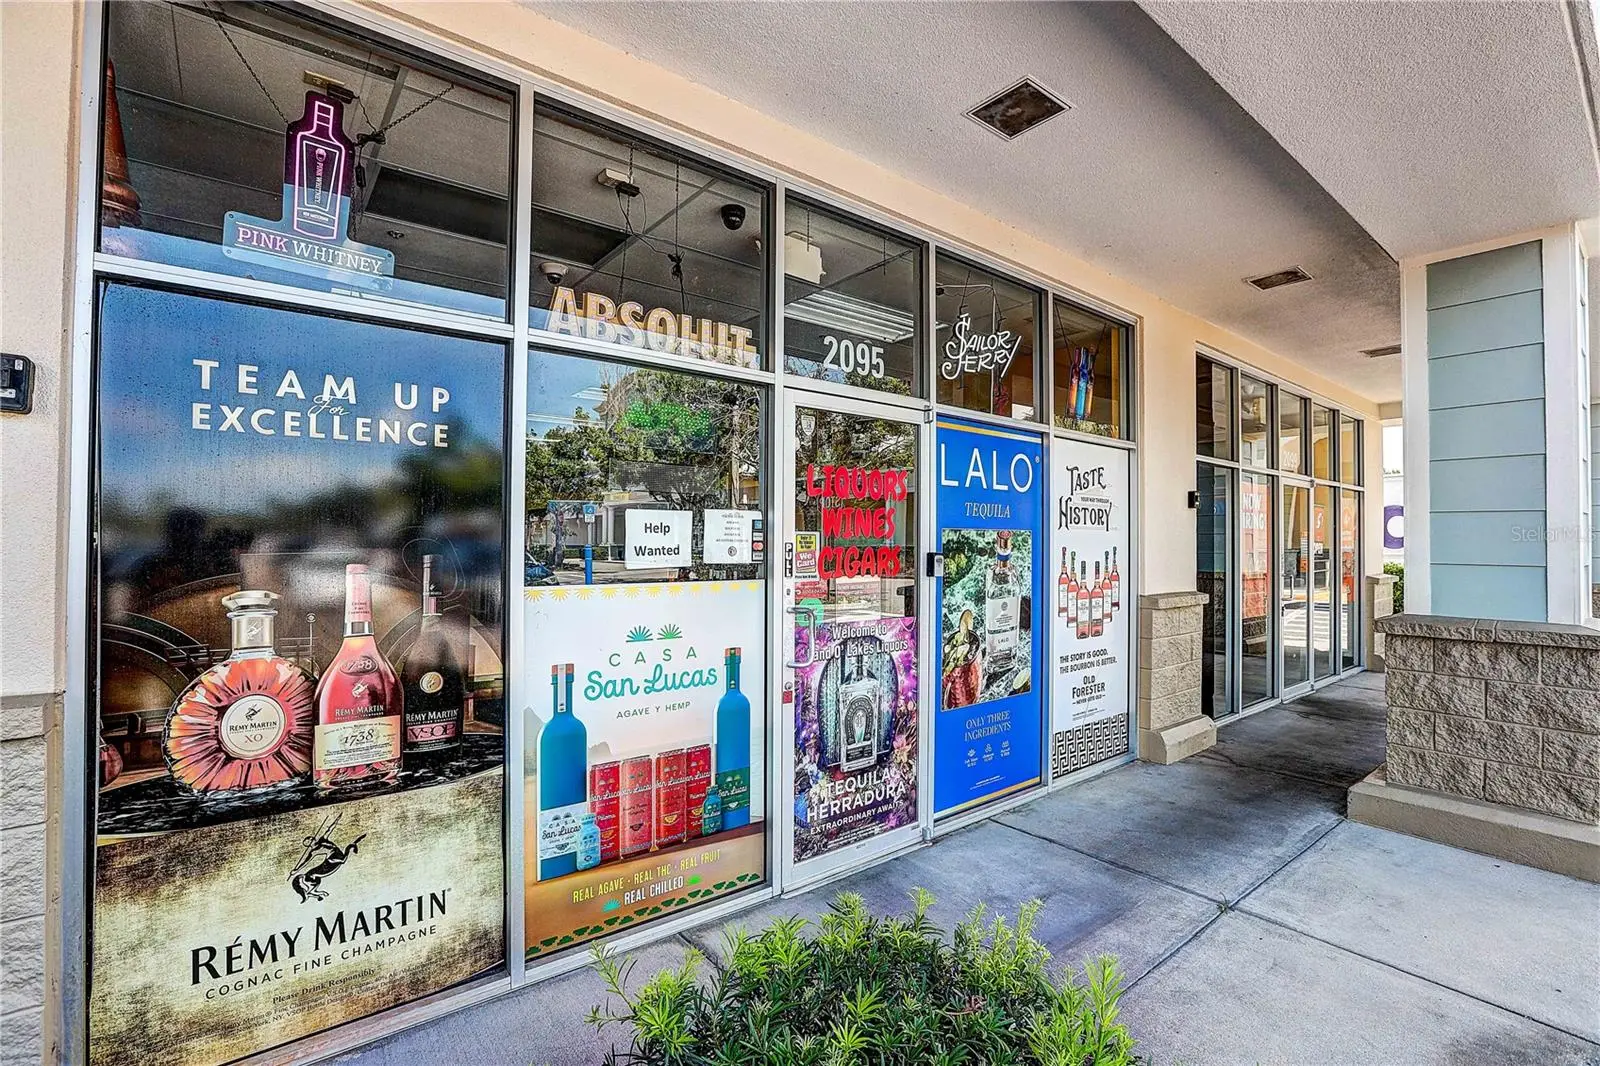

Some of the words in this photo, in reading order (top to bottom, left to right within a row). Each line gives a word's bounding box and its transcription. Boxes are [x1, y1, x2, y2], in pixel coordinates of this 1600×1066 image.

[236, 226, 288, 253] PINK
[292, 241, 383, 274] WHITNEY
[545, 286, 759, 370] ABSOLUT
[945, 314, 1011, 359] SAILOR
[823, 335, 885, 379] 2095
[941, 335, 1022, 380] JERRY
[192, 358, 357, 405] TEAM
[394, 382, 450, 413] UP
[307, 393, 351, 419] For
[192, 402, 449, 448] EXCELLENCE
[941, 443, 1033, 493] LALO
[806, 463, 908, 502] LIQUORS
[1066, 465, 1107, 496] TASTE
[965, 502, 1010, 520] TEQUILA
[1243, 493, 1262, 510] NOW
[822, 506, 897, 539] WINES
[1058, 496, 1112, 532] HISTORY
[643, 522, 671, 536] Help
[634, 544, 680, 557] Wanted
[785, 543, 793, 577] PULL
[799, 552, 812, 560] We
[817, 544, 901, 580] CIGARS
[796, 559, 816, 568] Card
[831, 624, 879, 640] Welcome
[879, 624, 887, 635] to
[608, 646, 698, 667] CASA
[811, 648, 831, 661] and
[834, 645, 844, 659] O'
[847, 642, 875, 657] Lakes
[876, 640, 908, 654] Liquors
[1060, 655, 1069, 664] THE
[1070, 652, 1086, 662] STORY
[1086, 651, 1091, 659] IS
[1060, 666, 1069, 674] THE
[1070, 661, 1095, 672] BOURBON
[1095, 659, 1100, 667] IS
[584, 670, 640, 701] San
[643, 663, 718, 695] Lucas
[1072, 682, 1106, 699] FORESTER
[1083, 675, 1096, 685] OLD
[356, 705, 384, 714] MARTIN
[428, 710, 457, 720] MARTIN
[616, 707, 650, 719] AGAVE
[655, 705, 661, 713] Y
[665, 701, 691, 712] HEMP
[965, 715, 986, 729] ONLY
[987, 710, 1011, 721] THREE
[250, 721, 277, 729] MARTIN
[409, 723, 455, 740] VSOP
[964, 721, 1012, 742] INGREDIENTS
[245, 734, 263, 743] XO
[343, 728, 375, 747] 1738
[826, 767, 892, 798] TEQUILA
[807, 781, 906, 823] HERRADURA
[548, 819, 576, 829] CASA
[810, 808, 877, 834] EXTRAORDINARY
[876, 800, 904, 814] AWAITS
[542, 830, 557, 840] San
[558, 825, 581, 837] Lucas
[572, 888, 593, 904] REAL
[598, 877, 624, 895] AGAVE
[634, 869, 654, 885] REAL
[656, 864, 672, 878] THC
[680, 859, 697, 872] REAL
[700, 849, 721, 864] FRUIT
[624, 889, 646, 905] REAL
[649, 876, 684, 898] CHILLED
[190, 927, 303, 986] RÉMY
[314, 889, 447, 951] MARTIN
[205, 969, 284, 1000] COGNAC
[293, 956, 332, 975] FINE
[341, 924, 438, 960] CHAMPAGNE
[272, 991, 299, 1004] Please
[302, 984, 326, 995] Drink
[328, 968, 376, 987] Responsibly
